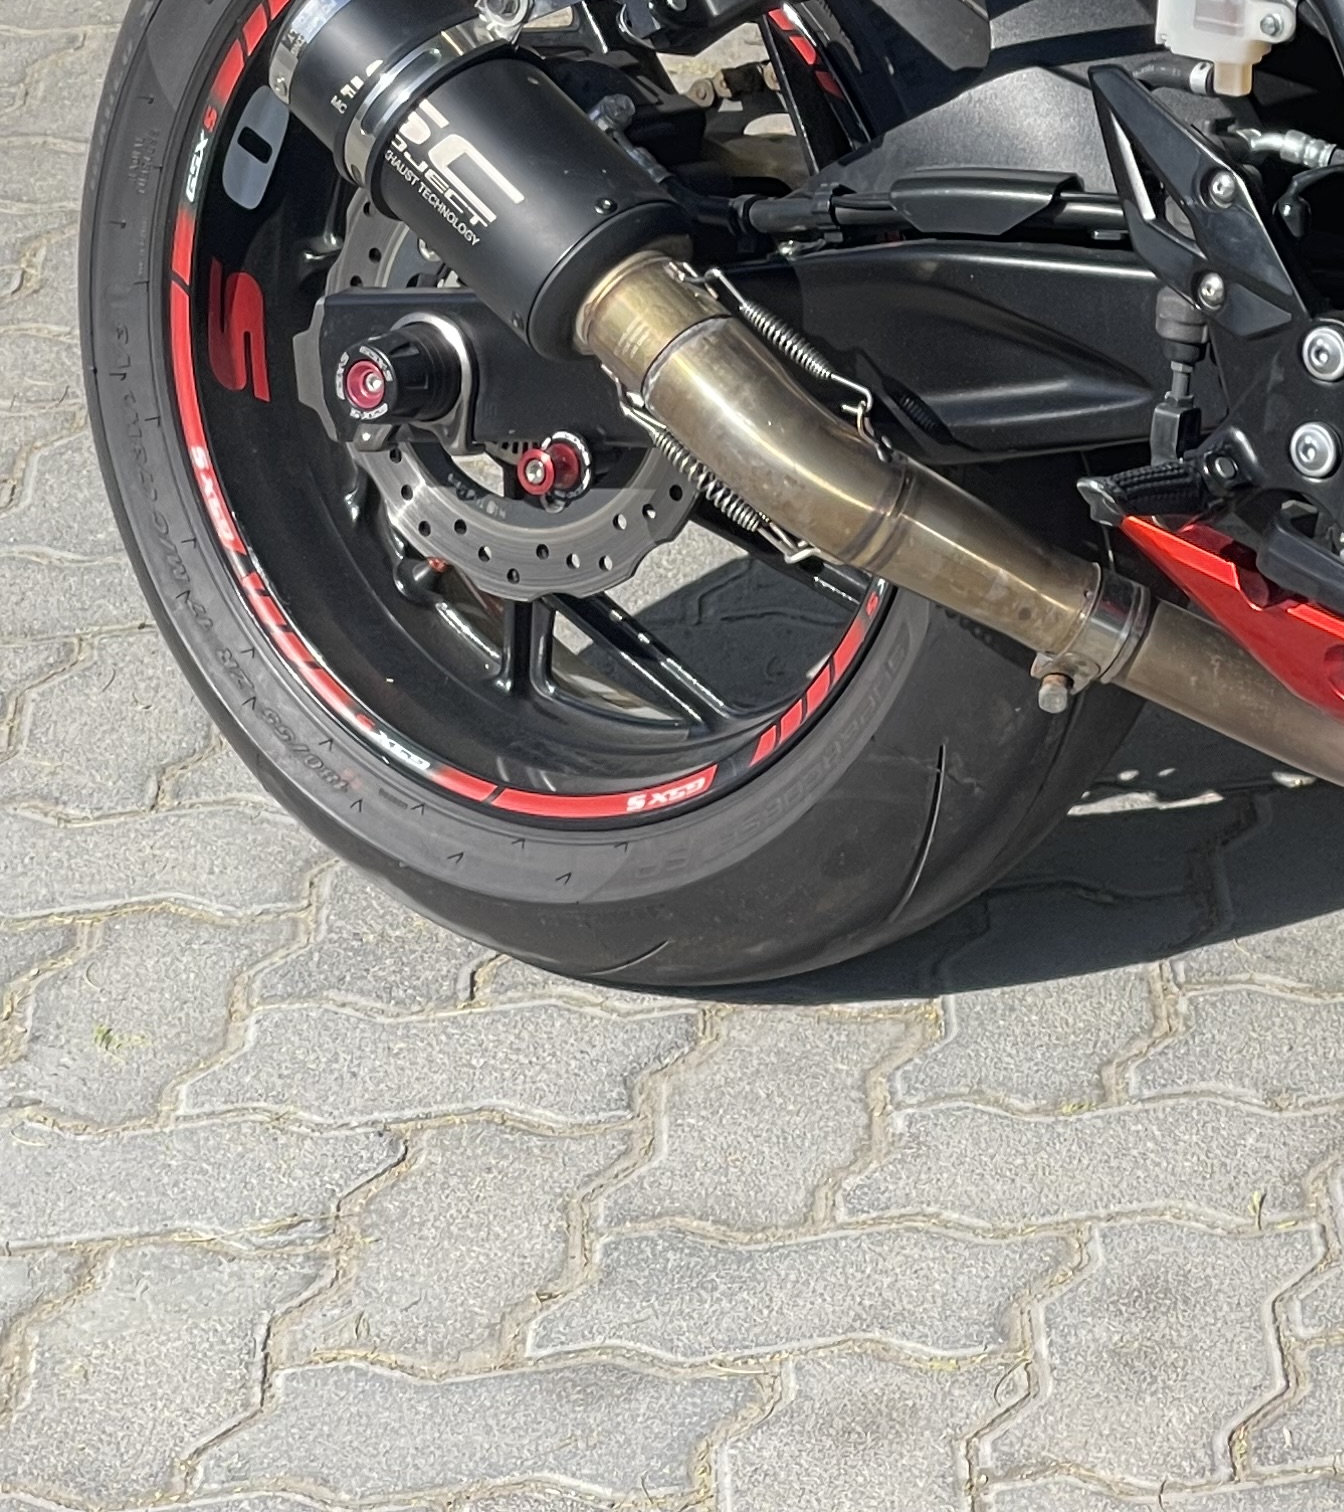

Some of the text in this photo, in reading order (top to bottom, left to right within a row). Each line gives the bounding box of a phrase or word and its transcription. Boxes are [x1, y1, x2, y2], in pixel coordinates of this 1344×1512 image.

[185, 104, 217, 203] GSX S
[418, 182, 480, 247] TECHNOLOGY
